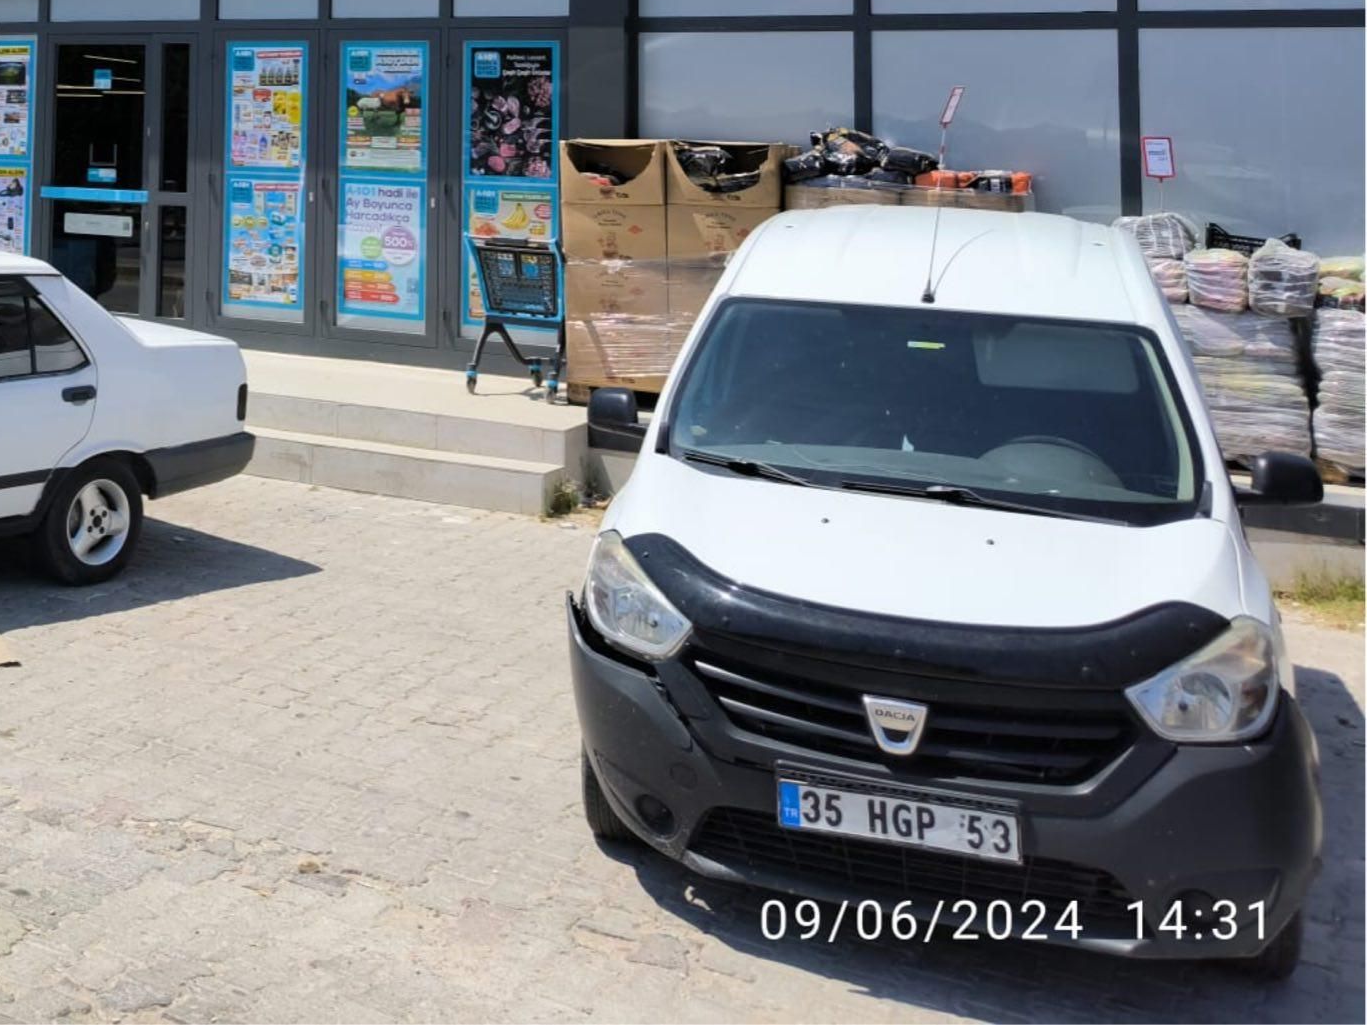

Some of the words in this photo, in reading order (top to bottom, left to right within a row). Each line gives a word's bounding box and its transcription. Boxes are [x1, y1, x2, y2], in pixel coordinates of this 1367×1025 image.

[363, 198, 413, 212] Boyunca
[874, 707, 916, 723] DACIA
[801, 790, 843, 827] 35
[867, 799, 936, 841] HGP
[966, 814, 1012, 854] 53
